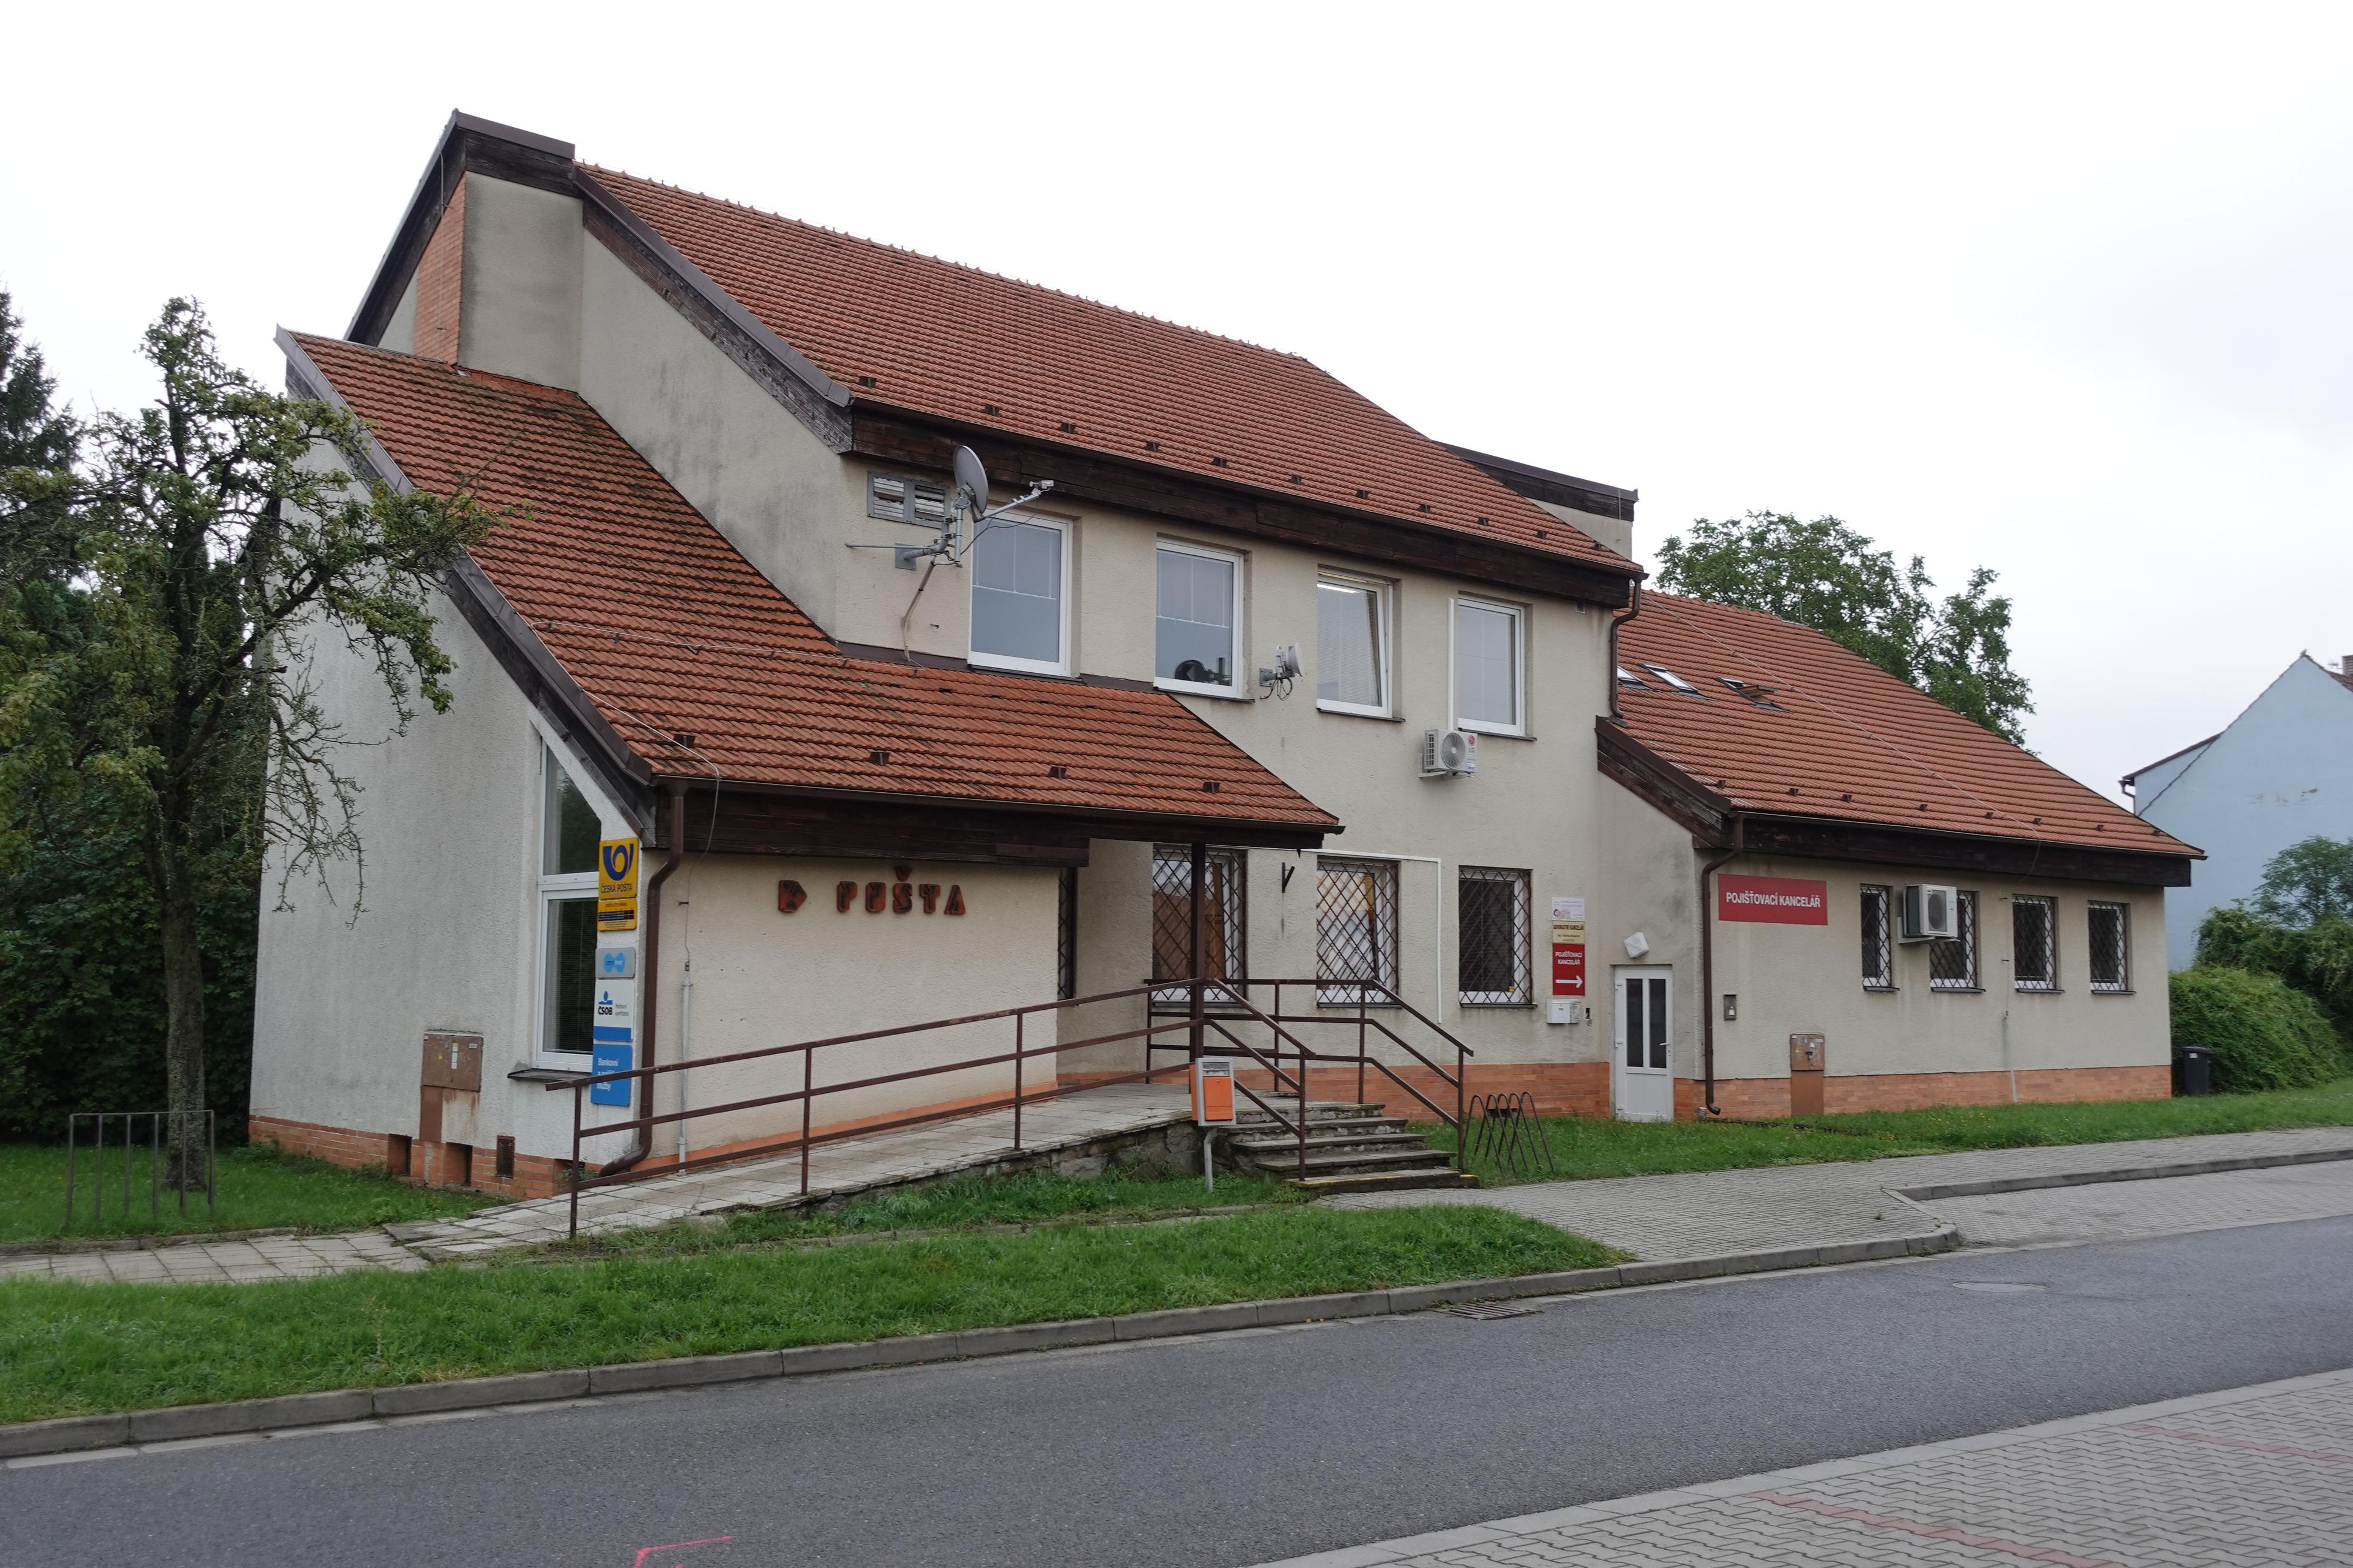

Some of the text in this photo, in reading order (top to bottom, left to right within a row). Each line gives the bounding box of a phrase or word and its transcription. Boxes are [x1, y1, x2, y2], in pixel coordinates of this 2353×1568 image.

[601, 882, 632, 893] ČESKÁ POŠTA
[837, 866, 966, 915] POŠTA
[1726, 890, 1821, 908] POJIŠŤOVACÍ KANCELÁŘ
[598, 1006, 612, 1015] ČSOB
[598, 1057, 619, 1066] Bankovní
